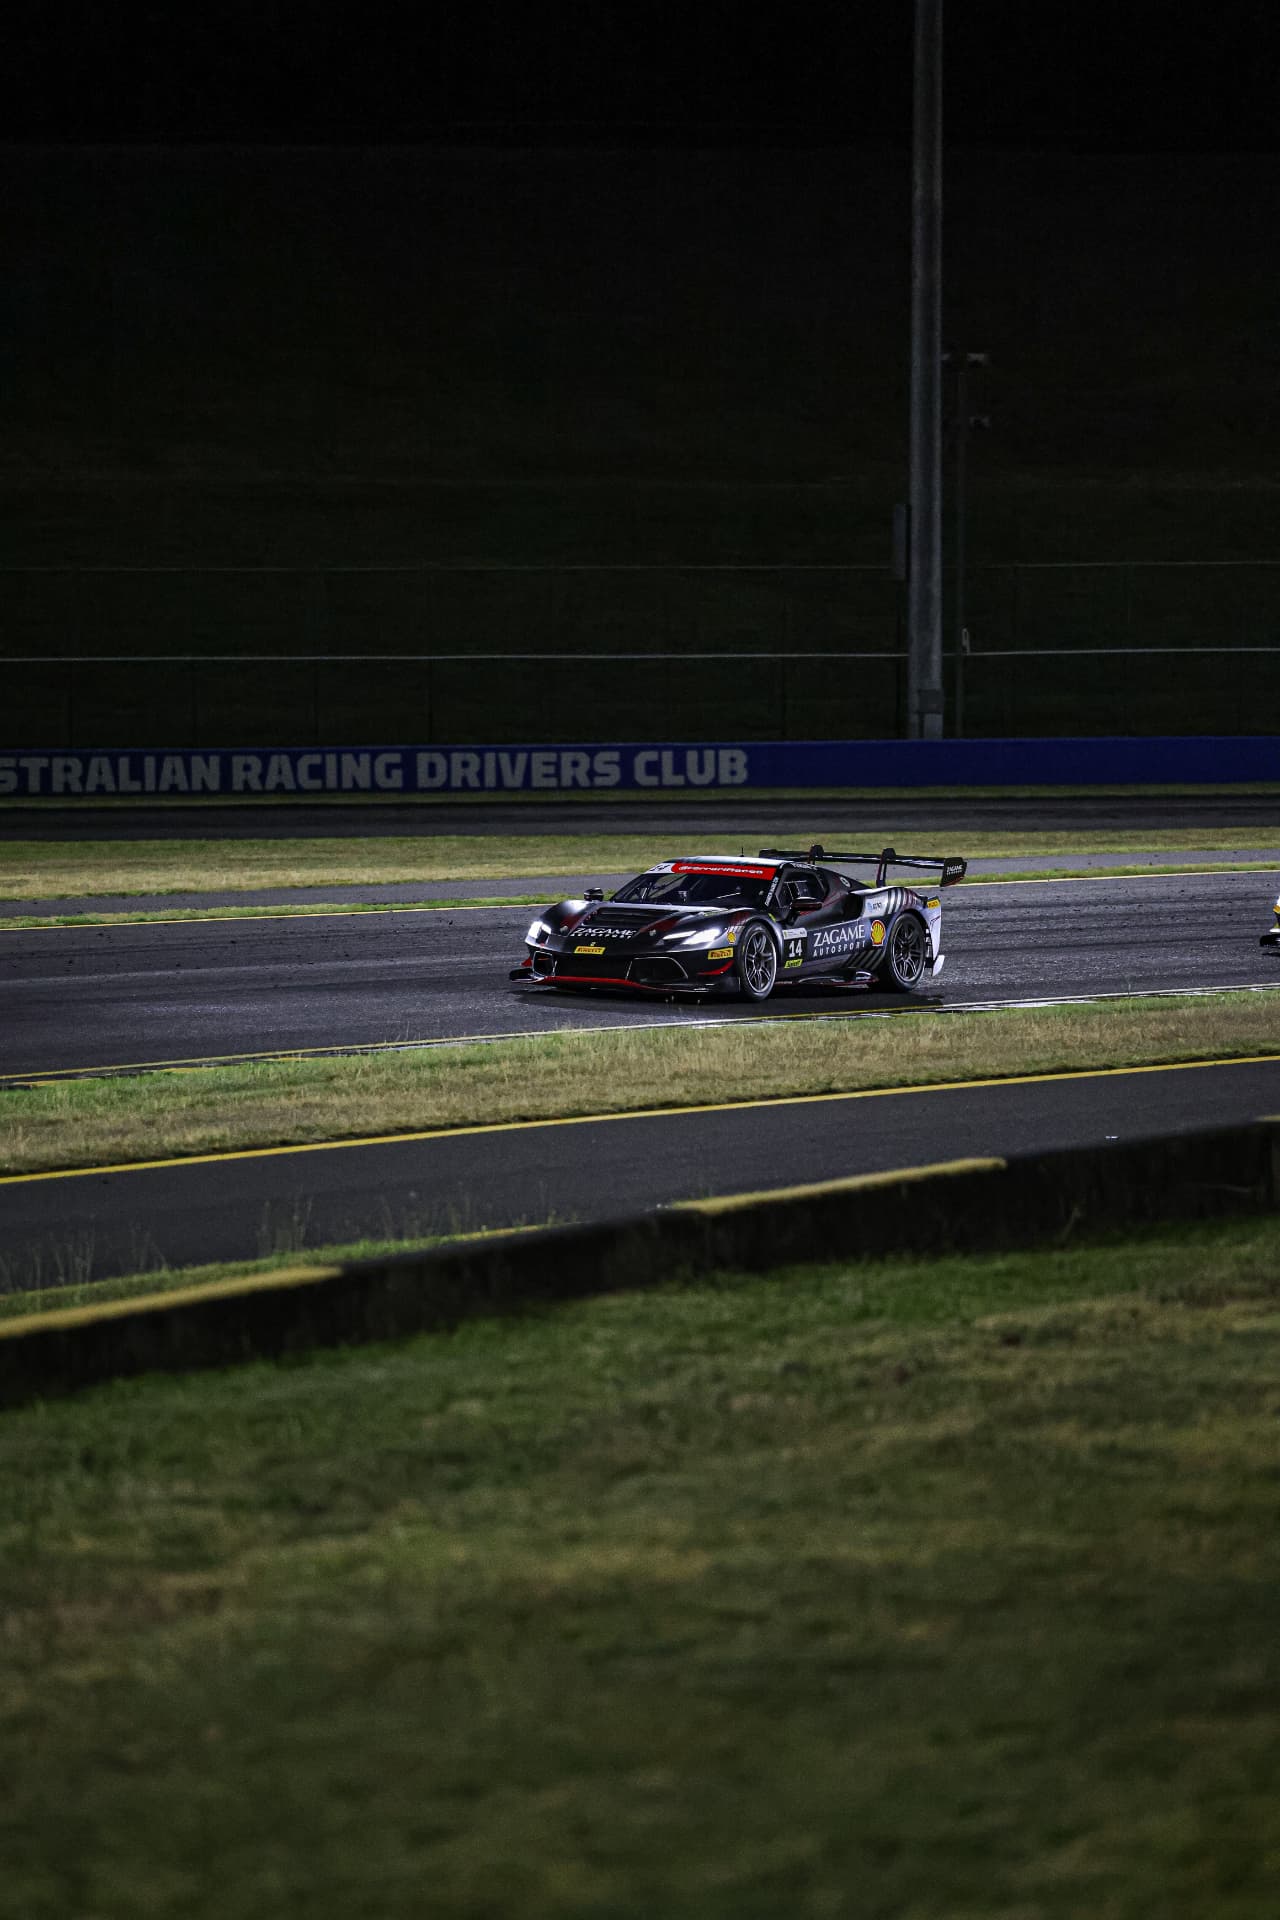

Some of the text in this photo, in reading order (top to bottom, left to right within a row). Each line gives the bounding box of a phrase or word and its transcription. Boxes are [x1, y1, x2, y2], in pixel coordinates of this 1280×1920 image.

[0, 748, 749, 793] STRALIAN RACING DRIVERS CLUB
[573, 927, 637, 936] ZAGAME
[813, 924, 866, 948] ZAGAME
[788, 939, 803, 958] 14
[812, 940, 866, 957] AUTOSPORT
